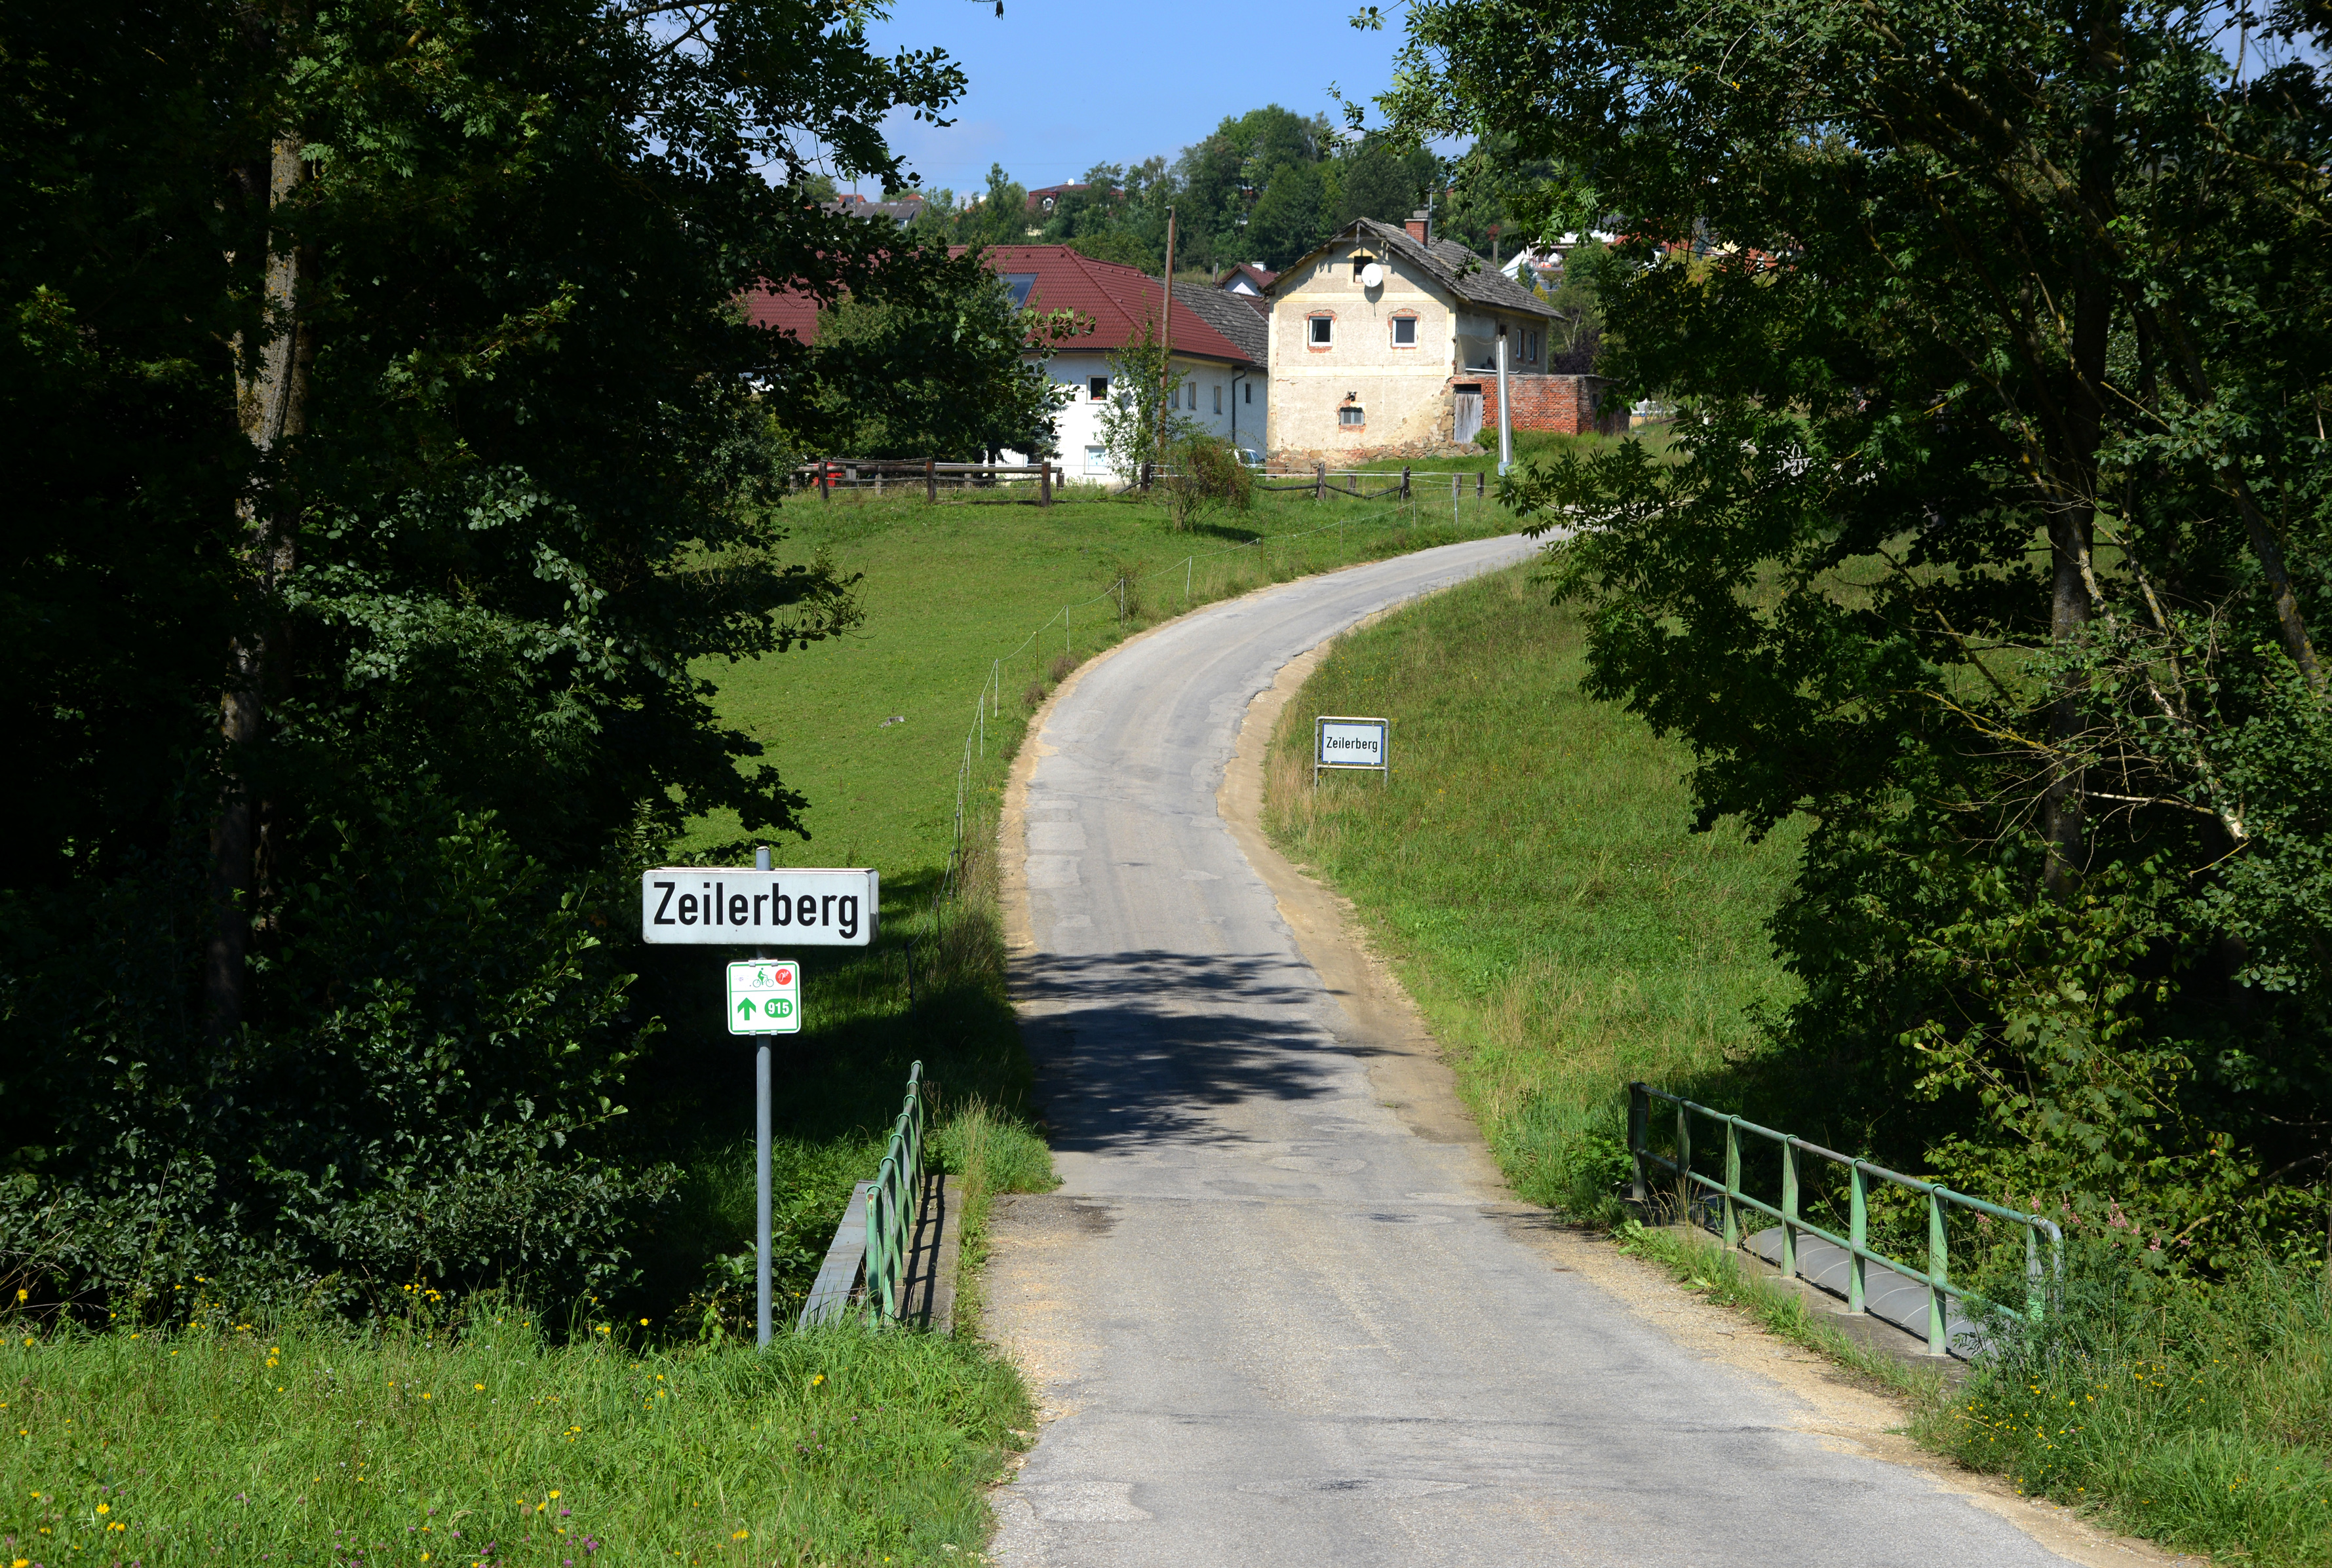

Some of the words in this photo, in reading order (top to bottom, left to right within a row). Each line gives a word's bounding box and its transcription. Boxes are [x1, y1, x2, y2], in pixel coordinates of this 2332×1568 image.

[1326, 736, 1378, 753] Zeilerberg
[653, 881, 858, 939] Zeilerberg
[768, 1002, 790, 1015] 915
